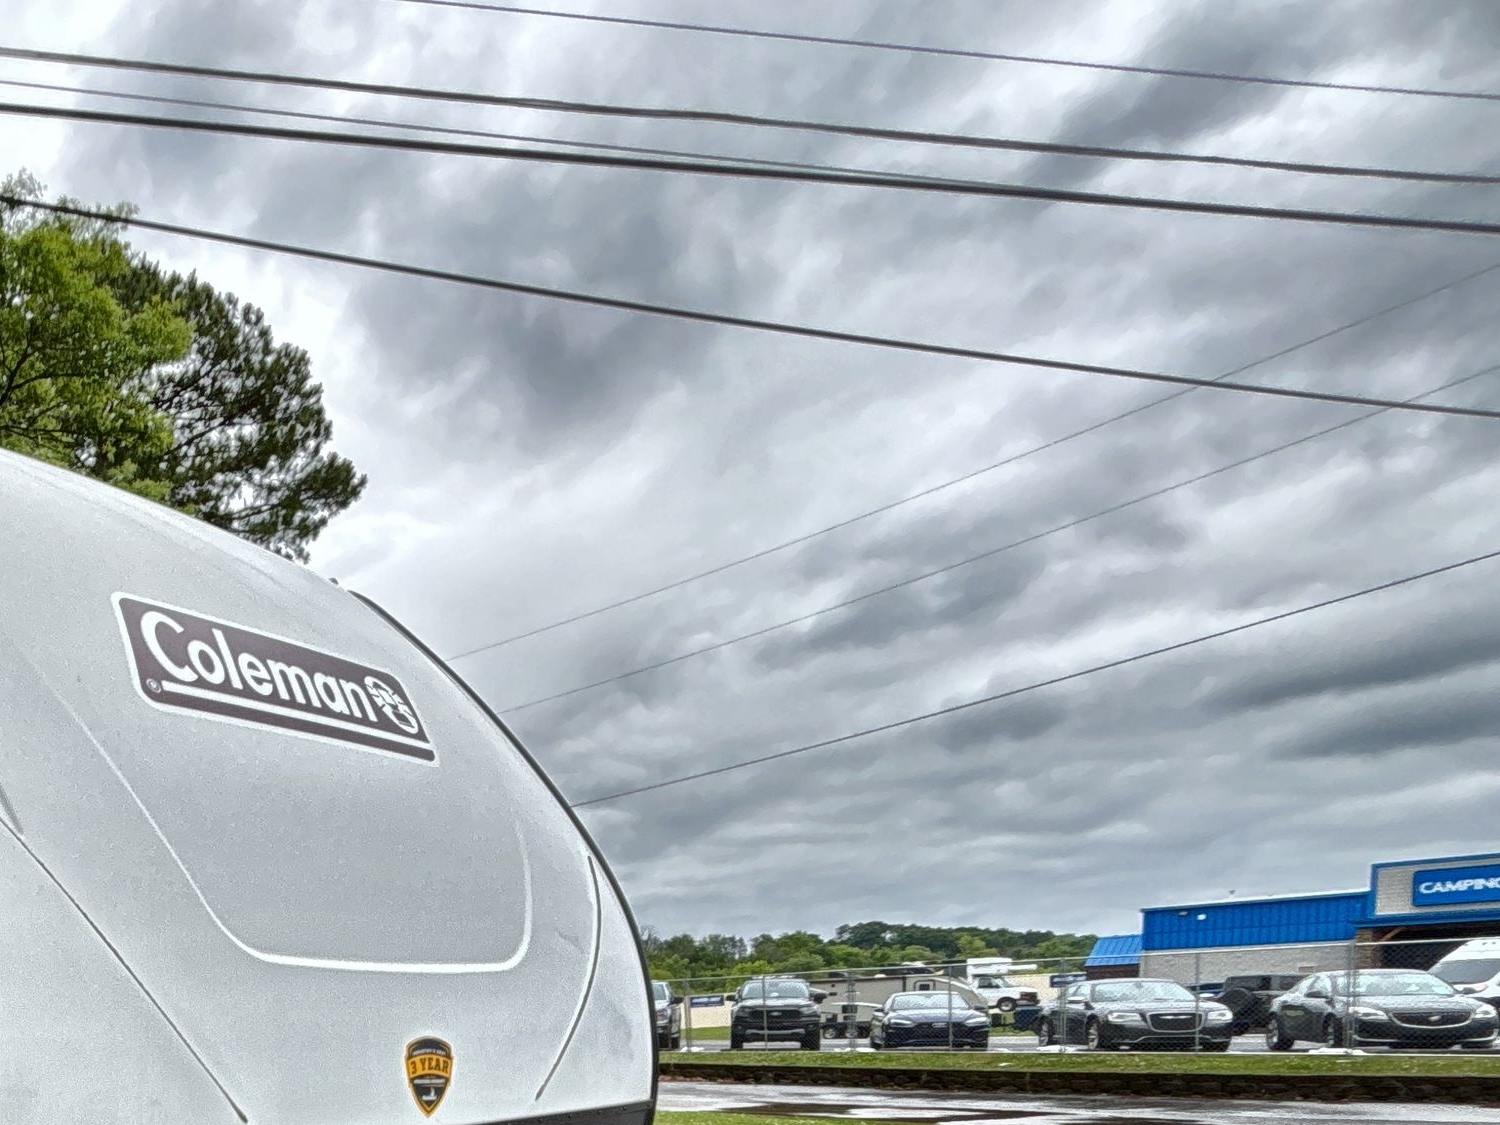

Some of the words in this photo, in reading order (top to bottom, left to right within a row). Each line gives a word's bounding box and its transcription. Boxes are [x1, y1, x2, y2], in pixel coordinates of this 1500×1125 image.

[141, 610, 378, 723] Coleman
[410, 1060, 417, 1075] 3
[420, 1057, 450, 1075] YEAR
